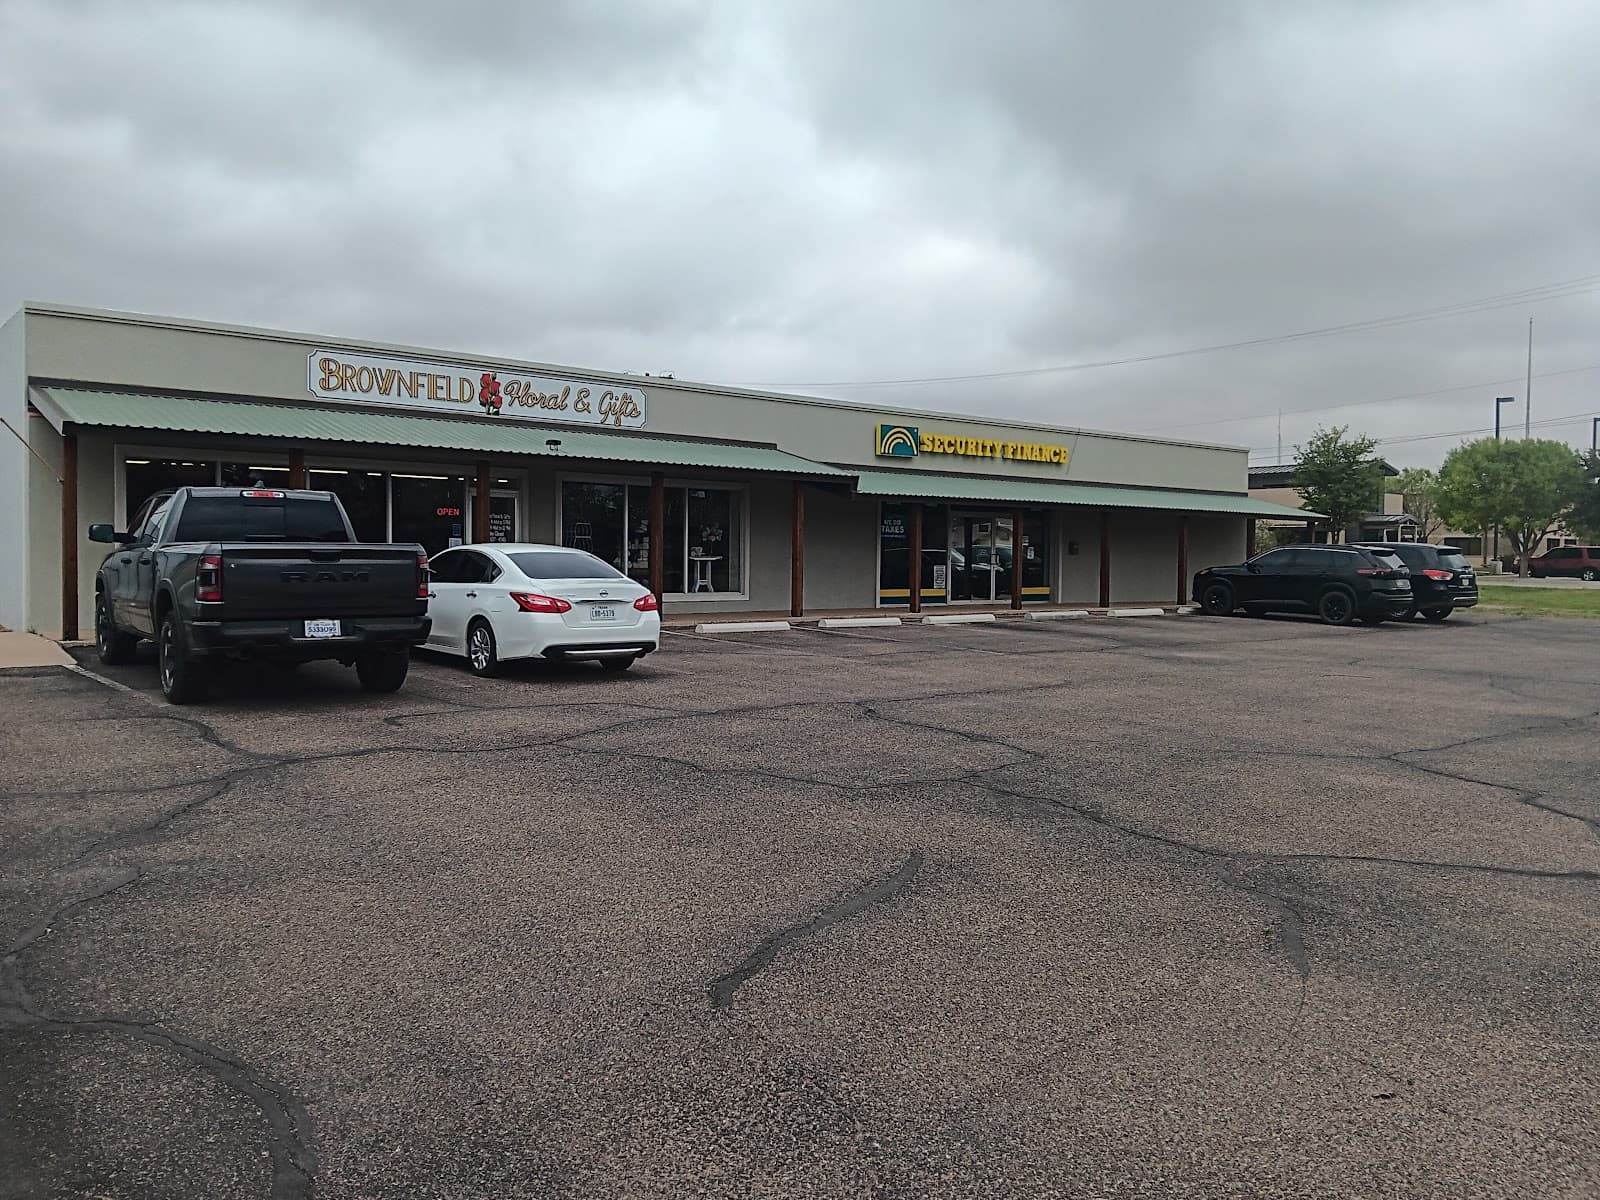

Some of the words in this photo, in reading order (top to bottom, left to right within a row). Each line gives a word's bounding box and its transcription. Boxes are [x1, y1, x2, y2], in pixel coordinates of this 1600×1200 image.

[318, 357, 475, 404] BROWNFIELD
[503, 379, 569, 410] Floral
[573, 388, 592, 413] &
[598, 390, 642, 427] Gifts
[920, 433, 1002, 458] SECURITY
[1002, 441, 1070, 464] FINANCE
[436, 507, 460, 516] OPEN
[881, 525, 904, 534] TAXES
[280, 571, 369, 583] RAM
